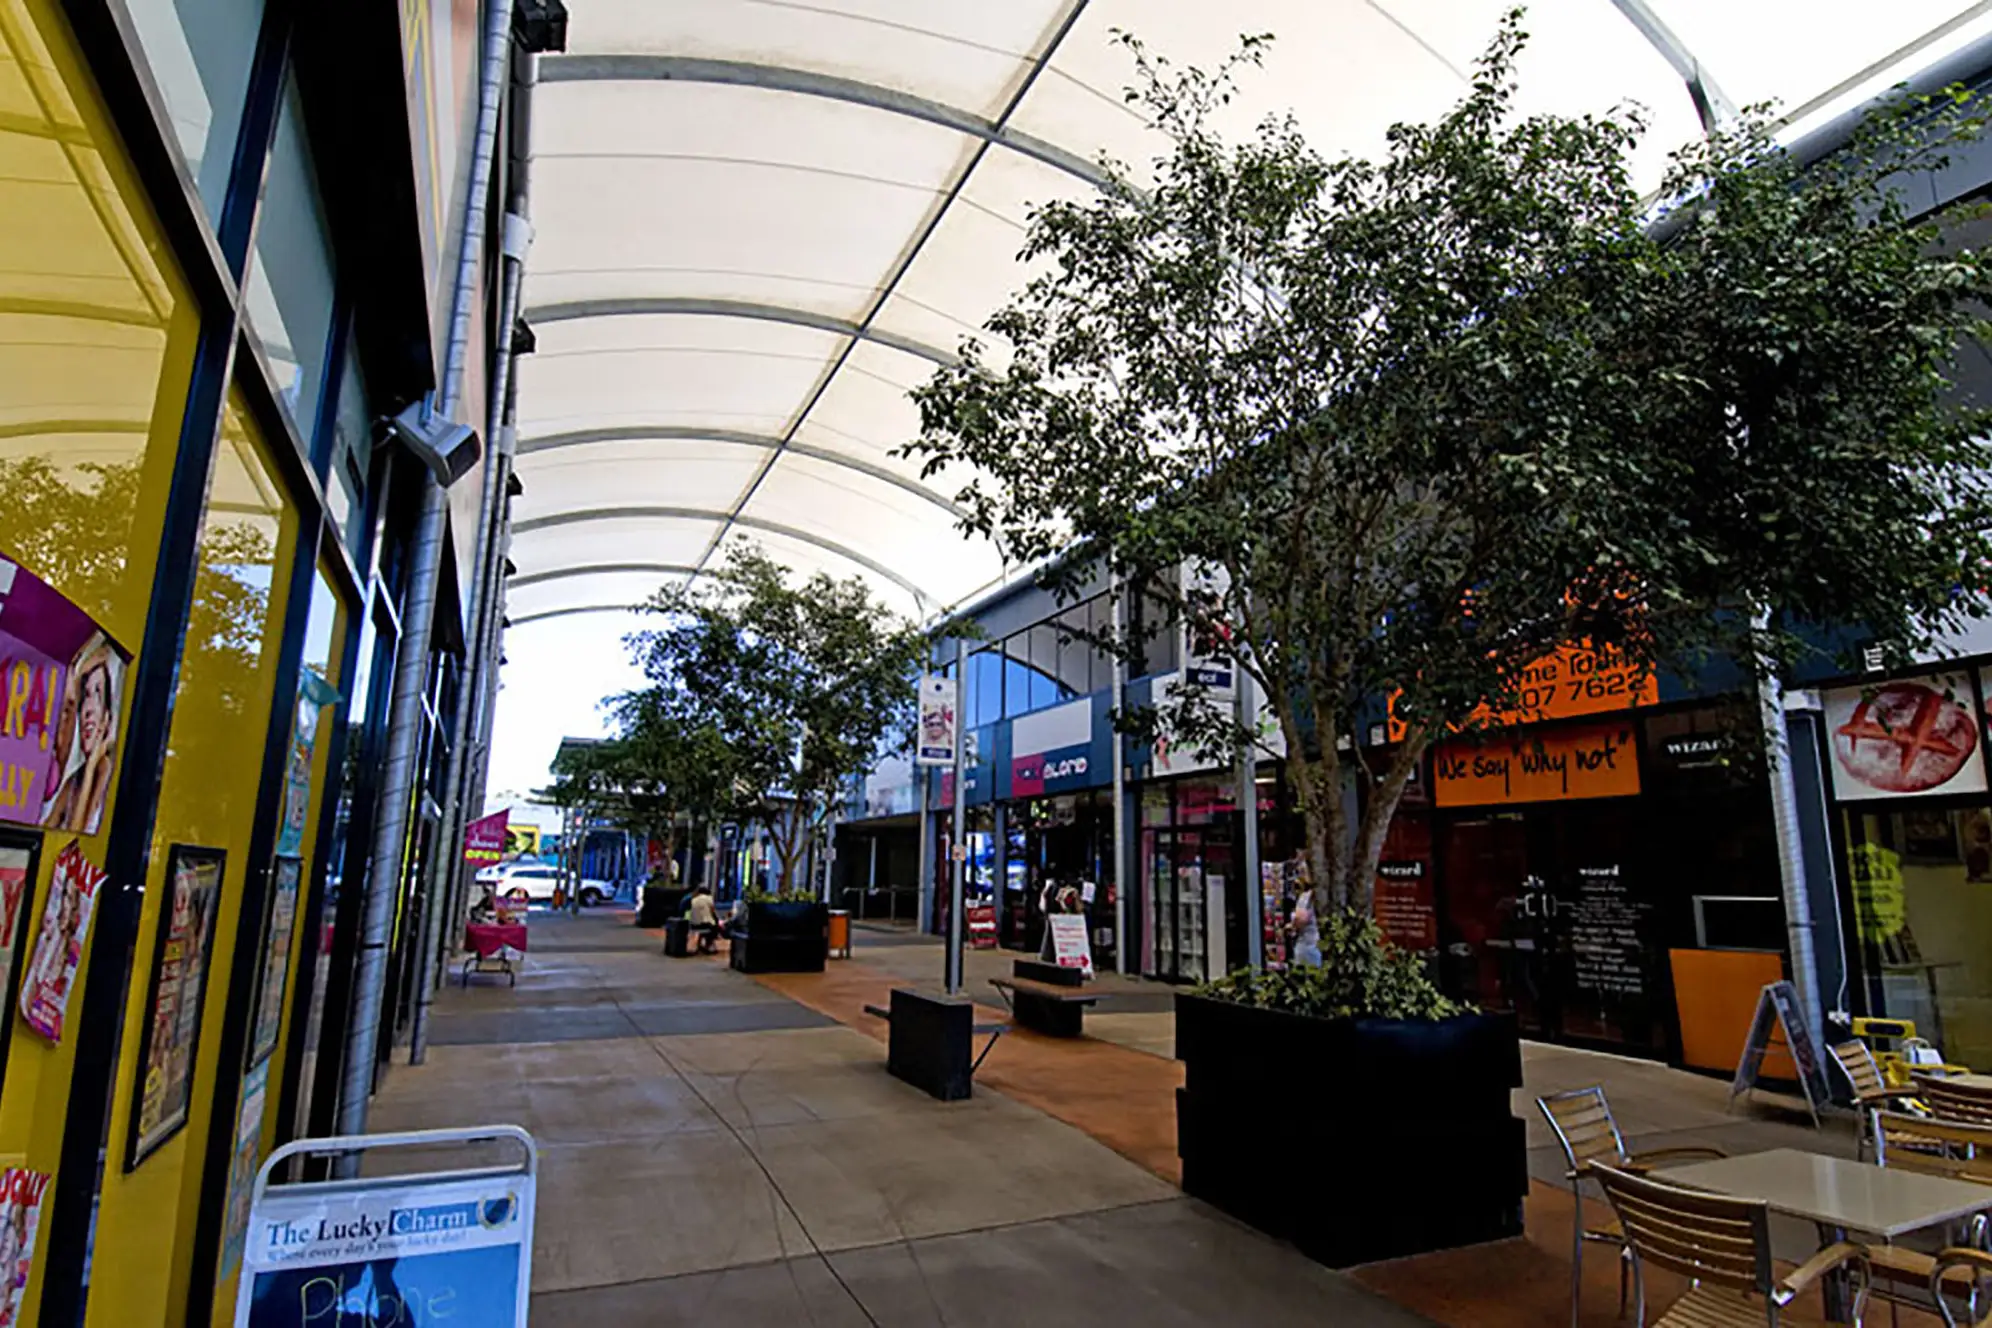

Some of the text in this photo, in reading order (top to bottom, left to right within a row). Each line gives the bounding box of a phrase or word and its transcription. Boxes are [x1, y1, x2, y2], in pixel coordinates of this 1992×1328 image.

[1438, 746, 1468, 781] We
[1473, 755, 1511, 797] say
[266, 1209, 468, 1246] The Lucky Charm
